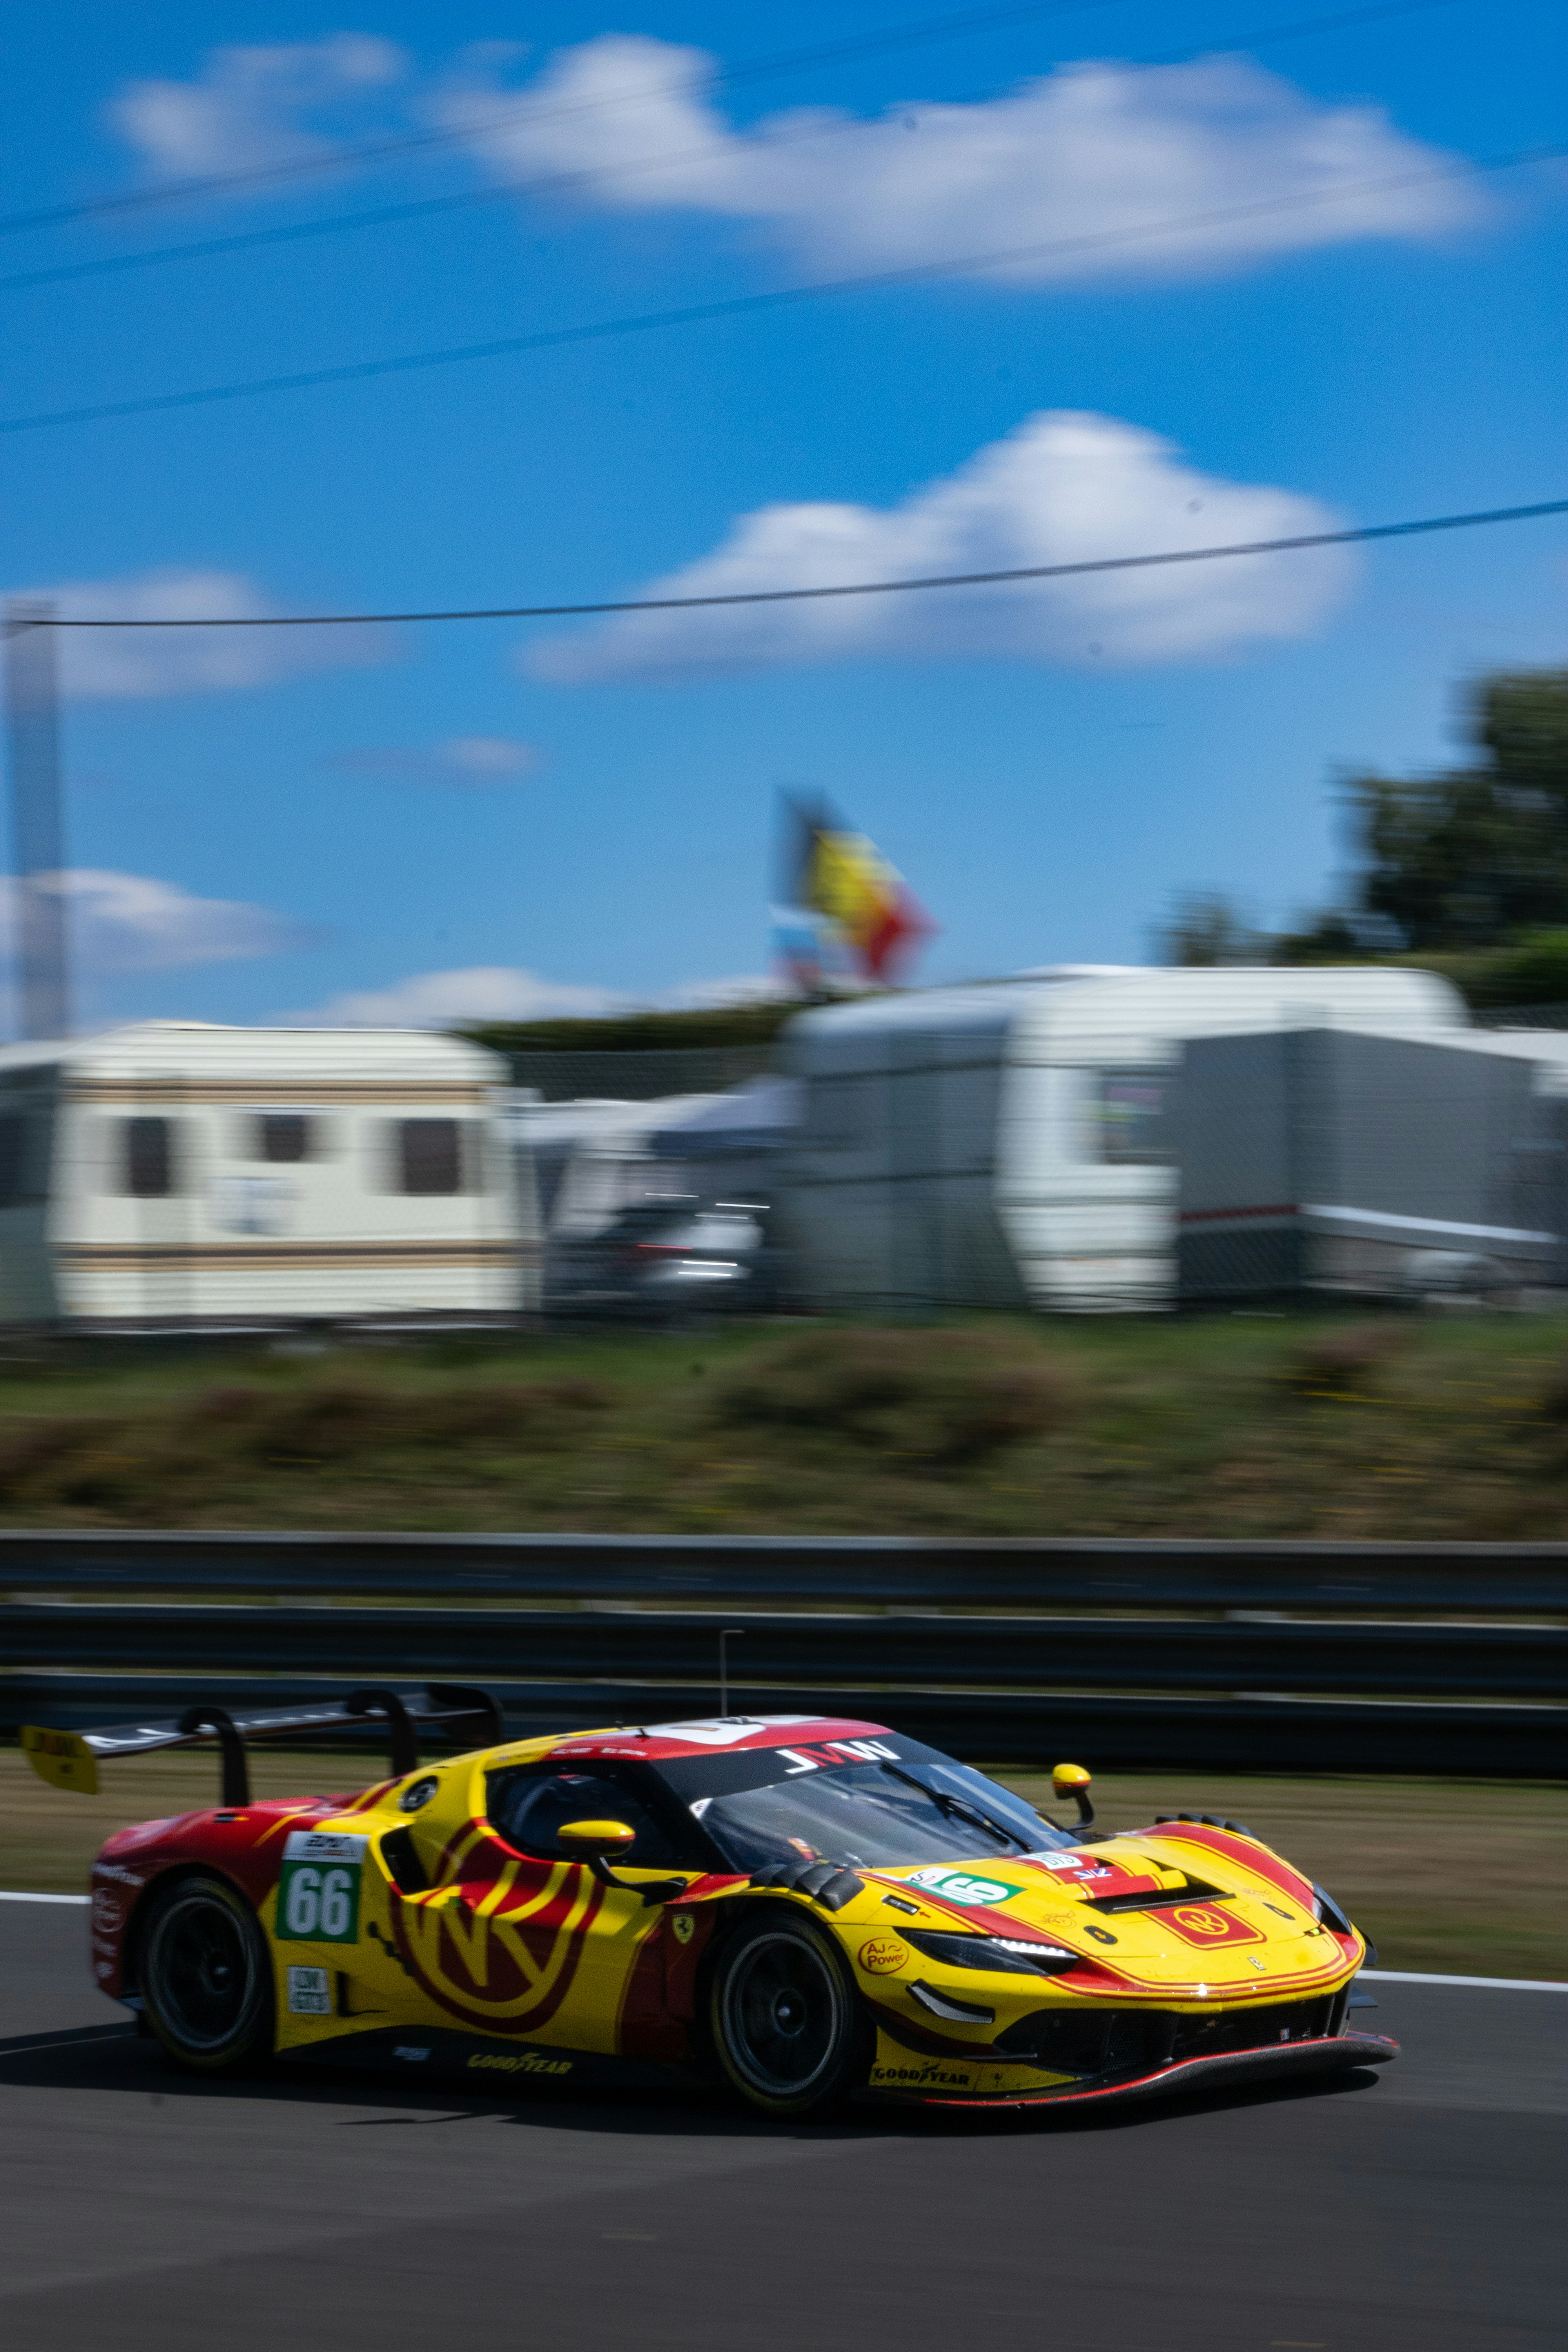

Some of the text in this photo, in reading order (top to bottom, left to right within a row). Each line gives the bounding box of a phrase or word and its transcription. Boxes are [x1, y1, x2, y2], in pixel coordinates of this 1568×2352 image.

[774, 1741, 902, 1774] JMW
[286, 1868, 352, 1935] 66
[867, 1943, 885, 1954] AJ
[867, 1955, 904, 1967] Power
